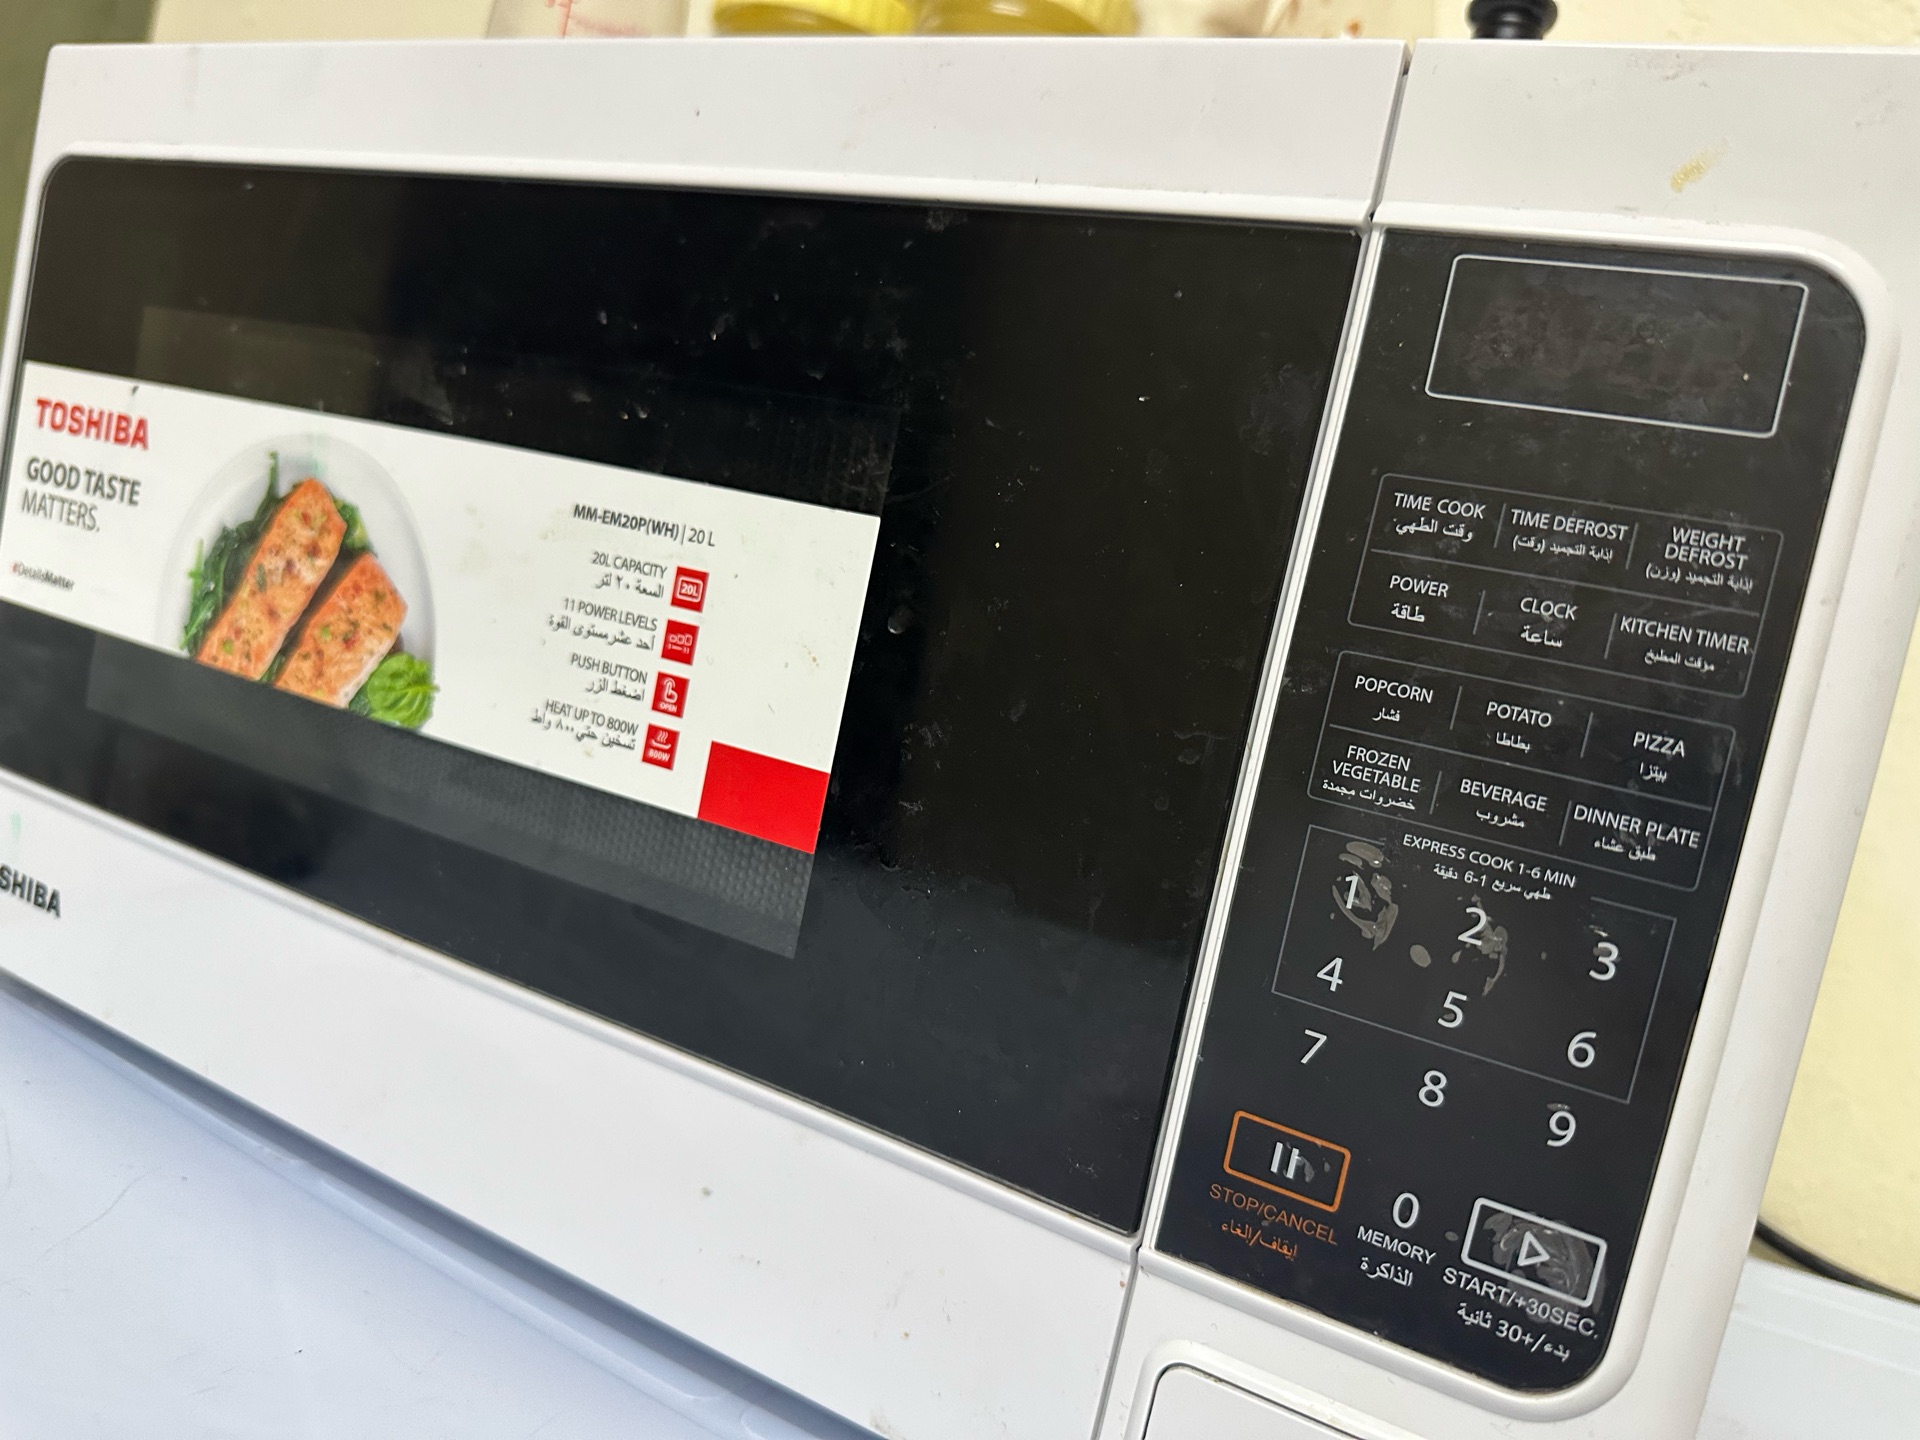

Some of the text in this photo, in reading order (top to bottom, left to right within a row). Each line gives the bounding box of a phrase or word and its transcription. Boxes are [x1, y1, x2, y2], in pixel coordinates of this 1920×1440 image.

[37, 397, 149, 450] TOSHIBA
[27, 457, 141, 506] GOOD TASTE
[21, 489, 100, 532] MATTERS.
[1394, 492, 1486, 519] TIME COOK
[573, 504, 716, 547] MM-EM20P(WH) 20 L
[1395, 517, 1473, 542] وقت الطهي
[1511, 508, 1629, 541] TIME DEFROST
[1672, 526, 1746, 552] WEIGHT
[592, 551, 668, 579] 20L CAPACITY
[1664, 543, 1748, 571] DEFROST
[635, 579, 664, 599] السعة
[681, 583, 698, 597] 20L
[1390, 575, 1449, 598] POWER
[564, 598, 658, 632] 11 POWER LEVELS
[1391, 603, 1425, 622] طاقة
[1520, 597, 1578, 620] CLOCK
[1521, 625, 1562, 647] ساعة
[1620, 616, 1749, 655] KITCHEN TIMER
[571, 652, 648, 685] PUSH BUTTON
[1355, 675, 1433, 703] POPCORN
[545, 699, 639, 736] HEAT UP TO 800W
[1373, 708, 1400, 722] فشار
[1487, 702, 1552, 728] POTATO
[1347, 745, 1411, 771] FROZEN
[1496, 732, 1530, 753] بطاطا
[1633, 731, 1685, 757] PIZZA
[1332, 760, 1421, 793] VEGETABLE
[1322, 779, 1415, 810] خضروات مجمدة
[1460, 778, 1548, 812] BEVERAGE
[1475, 809, 1525, 828] مشروب
[1573, 804, 1701, 849] DINNER PLATE
[1403, 833, 1576, 888] EXPRESS COOK 1-6 MIN
[1344, 874, 1360, 909] 1
[1458, 907, 1488, 946] 2
[1316, 957, 1344, 991] 4
[1589, 942, 1619, 981] 3
[1437, 991, 1468, 1028] 5
[1300, 1029, 1328, 1064] 7
[1567, 1031, 1597, 1069] 6
[1418, 1070, 1448, 1107] 8
[1546, 1109, 1577, 1147] 9
[1209, 1183, 1338, 1245] STOP/CANCEL
[1392, 1192, 1420, 1229] 0
[1357, 1225, 1436, 1265] MEMORY
[1360, 1256, 1413, 1287] الذاكرة
[1443, 1267, 1599, 1339] START/+30SEC.
[1457, 1302, 1492, 1329] ثانية
